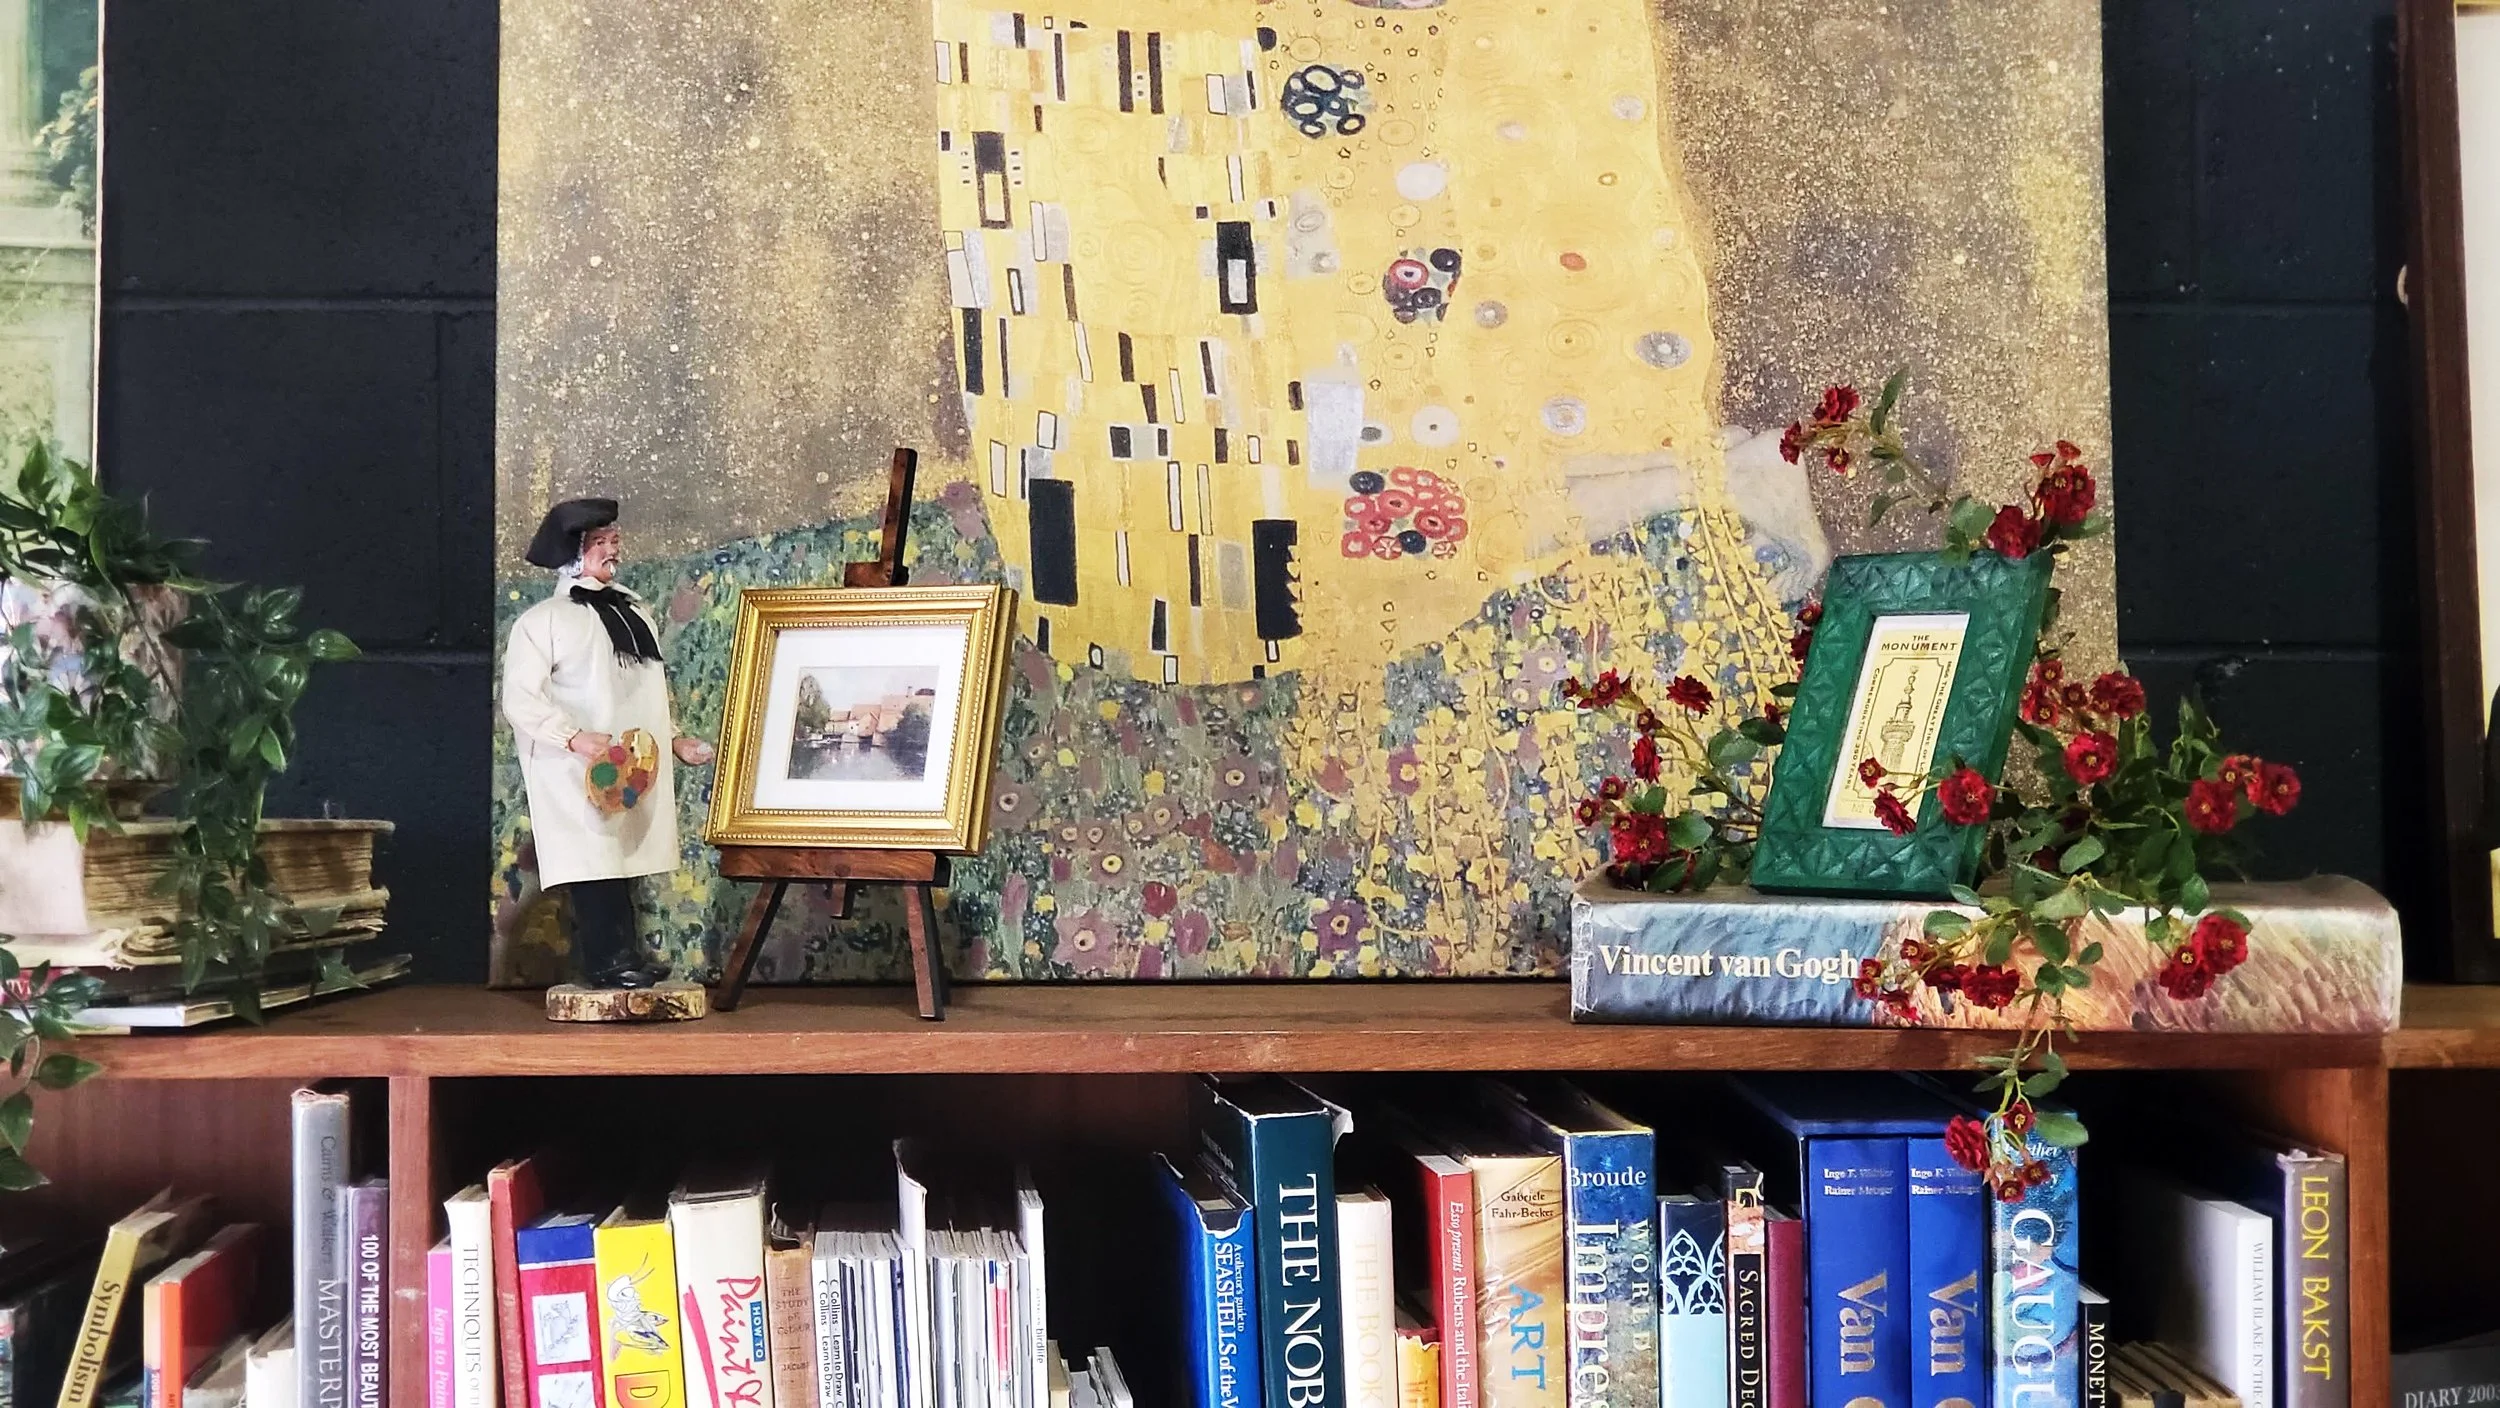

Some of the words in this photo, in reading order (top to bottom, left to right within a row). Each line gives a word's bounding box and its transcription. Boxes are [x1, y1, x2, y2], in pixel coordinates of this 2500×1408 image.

[1881, 642, 1958, 651] MONUMENT
[1944, 661, 1952, 678] 1666
[1598, 945, 1714, 977] Vincent
[1718, 955, 1771, 978] van
[1775, 947, 1860, 985] Gogh
[1568, 1167, 1647, 1188] Broude
[1823, 1168, 1846, 1181] Ingo
[1911, 1167, 1933, 1180] Ingo
[1500, 1191, 1545, 1202] Gabriele
[1824, 1185, 1856, 1196] Rainer
[1449, 1200, 1464, 1229] Esso
[1491, 1207, 1554, 1220] Fahr-Becker
[2300, 1176, 2330, 1261] LEON
[1278, 1173, 1320, 1287] THE
[360, 1234, 379, 1259] 100
[1447, 1229, 1464, 1274] presents
[360, 1261, 379, 1282] OF
[1234, 1252, 1245, 1296] collector's
[1354, 1239, 1381, 1304] THE
[1630, 1219, 1653, 1352] WORLD
[2253, 1242, 2264, 1302] WILLIAM
[360, 1284, 379, 1314] THE
[775, 1299, 809, 1310] STUDY
[782, 1287, 801, 1297] THE
[1214, 1242, 1238, 1355] SEASHELLS
[1452, 1275, 1469, 1328] Rubens
[461, 1244, 481, 1373] TECHNIQUES
[752, 1306, 763, 1339] HOW
[819, 1293, 830, 1325] Collins
[830, 1291, 841, 1325] Collins
[1234, 1296, 1247, 1321] guide
[1738, 1269, 1759, 1360] SACRED
[1837, 1268, 1888, 1377] Van
[360, 1316, 379, 1360] MOST
[716, 1275, 762, 1377] Paint
[1236, 1321, 1246, 1333] to
[1509, 1283, 1547, 1391] ART
[1928, 1269, 1979, 1378] Van
[2253, 1306, 2264, 1350] BLAKE
[2301, 1276, 2331, 1381] BAKST
[68, 1280, 121, 1403] Symbolism
[754, 1339, 765, 1359] TO
[821, 1335, 831, 1361] Learn
[832, 1334, 842, 1360] Learn
[1035, 1328, 1046, 1364] birdlife
[1454, 1329, 1470, 1356] and
[434, 1349, 448, 1365] to
[823, 1362, 832, 1372] to
[834, 1361, 843, 1371] to
[1219, 1355, 1237, 1372] of
[1356, 1312, 1385, 1408] BOOK
[1456, 1357, 1470, 1381] the
[2253, 1353, 2264, 1367] IN
[615, 1369, 671, 1408] D
[824, 1373, 834, 1398] Draw
[834, 1372, 844, 1397] Draw
[1220, 1374, 1238, 1398] the
[2253, 1369, 2264, 1398] THE
[2405, 1386, 2464, 1408] DIARY
